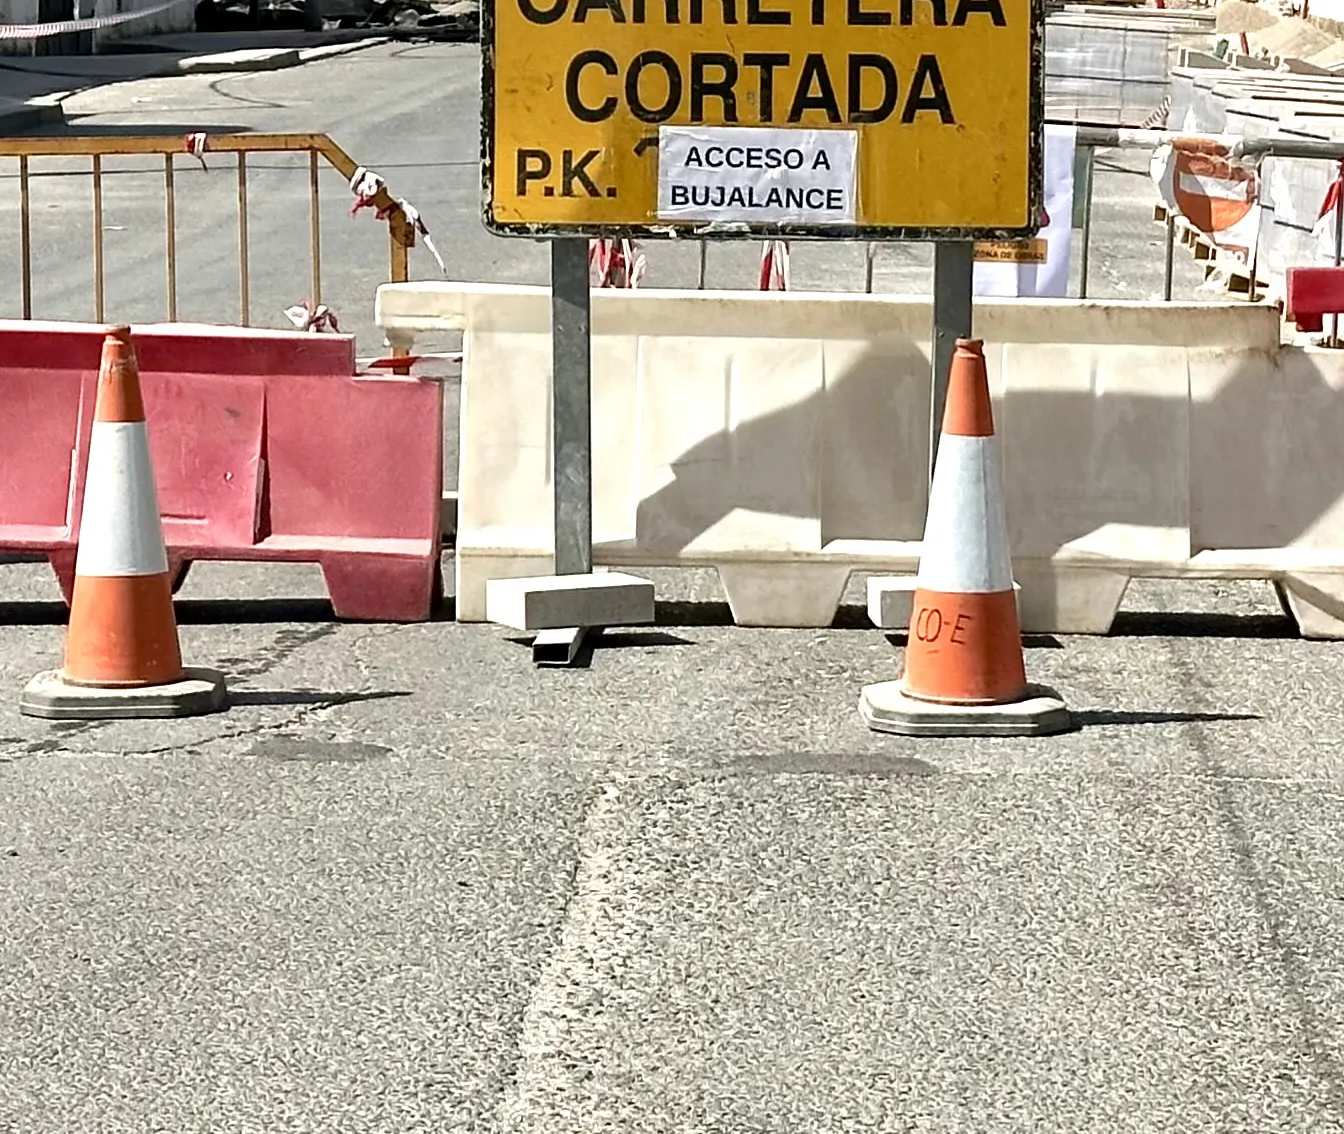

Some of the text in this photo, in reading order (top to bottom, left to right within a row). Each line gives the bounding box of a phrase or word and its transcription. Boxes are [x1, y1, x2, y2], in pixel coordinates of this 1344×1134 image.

[565, 50, 957, 125] CORTADA
[516, 148, 617, 197] P.K.
[684, 146, 804, 170] ACCESO
[811, 149, 831, 170] A
[670, 185, 844, 210] BUJALANCE
[916, 607, 972, 645] CO-E
